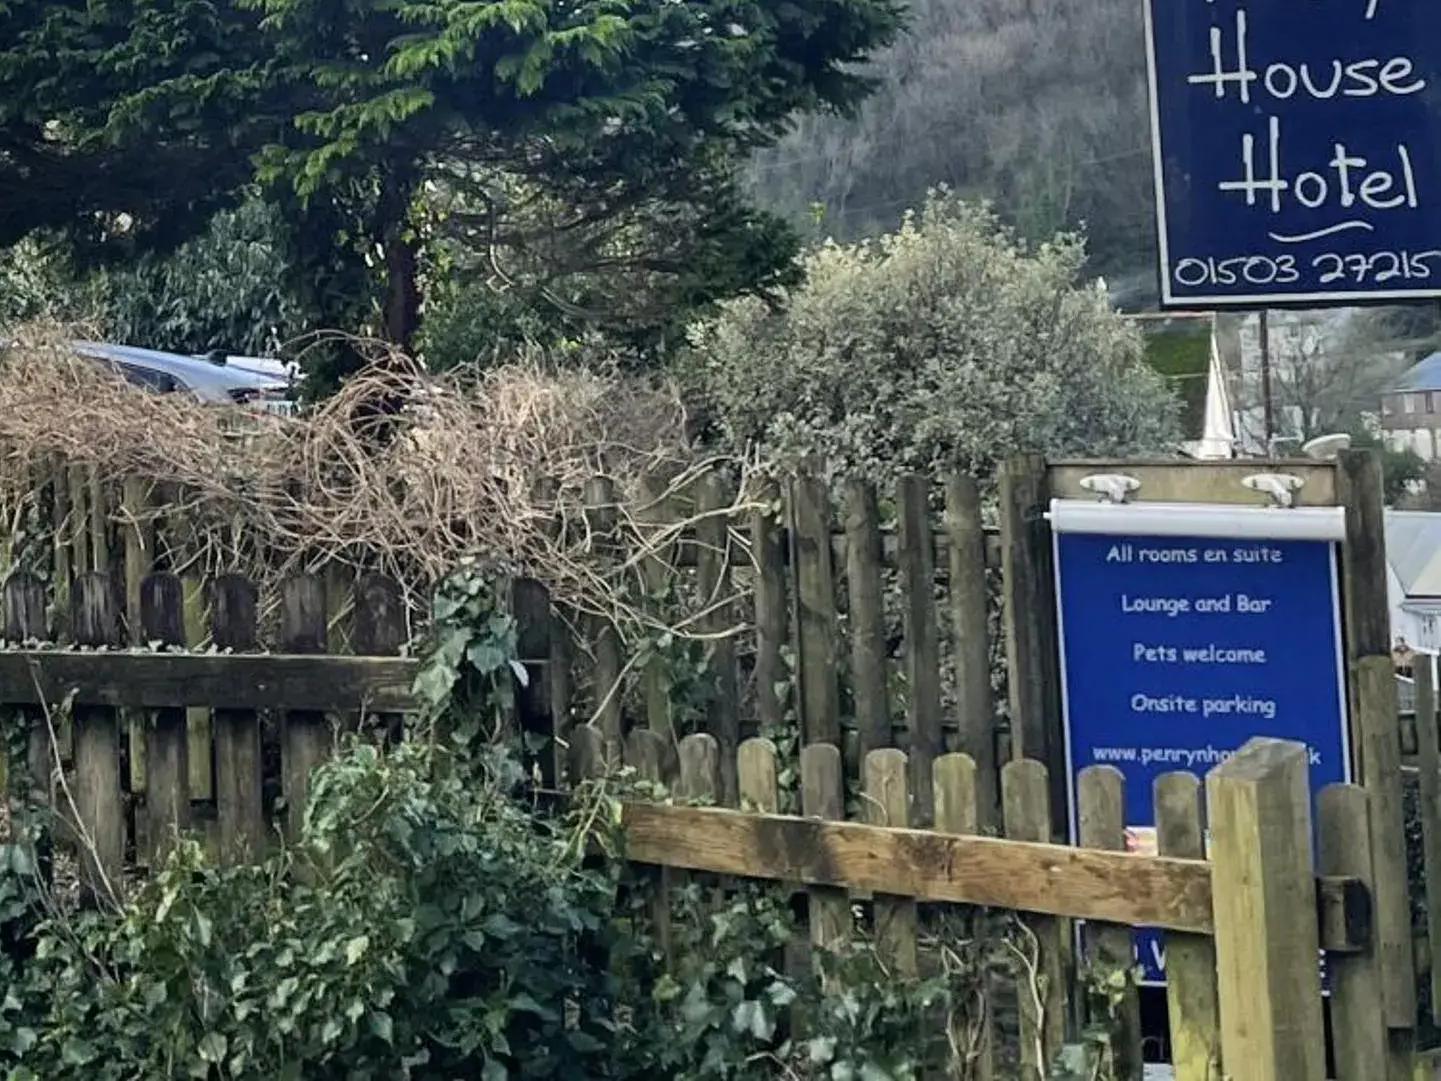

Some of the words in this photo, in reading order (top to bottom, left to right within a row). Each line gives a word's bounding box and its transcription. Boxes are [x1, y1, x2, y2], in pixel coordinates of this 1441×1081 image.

[1187, 9, 1426, 104] House
[1218, 116, 1418, 213] Hotel
[1174, 254, 1300, 286] 01503
[1106, 544, 1133, 563] All
[1139, 547, 1198, 563] rooms
[1204, 549, 1227, 563] en
[1233, 547, 1283, 564] suite
[1121, 594, 1190, 618] Lounge
[1195, 595, 1231, 613] and
[1237, 594, 1272, 613] Bar
[1133, 643, 1177, 662] Pets
[1183, 644, 1267, 664] welcome
[1131, 693, 1197, 713] Onsite
[1202, 695, 1276, 719] parking
